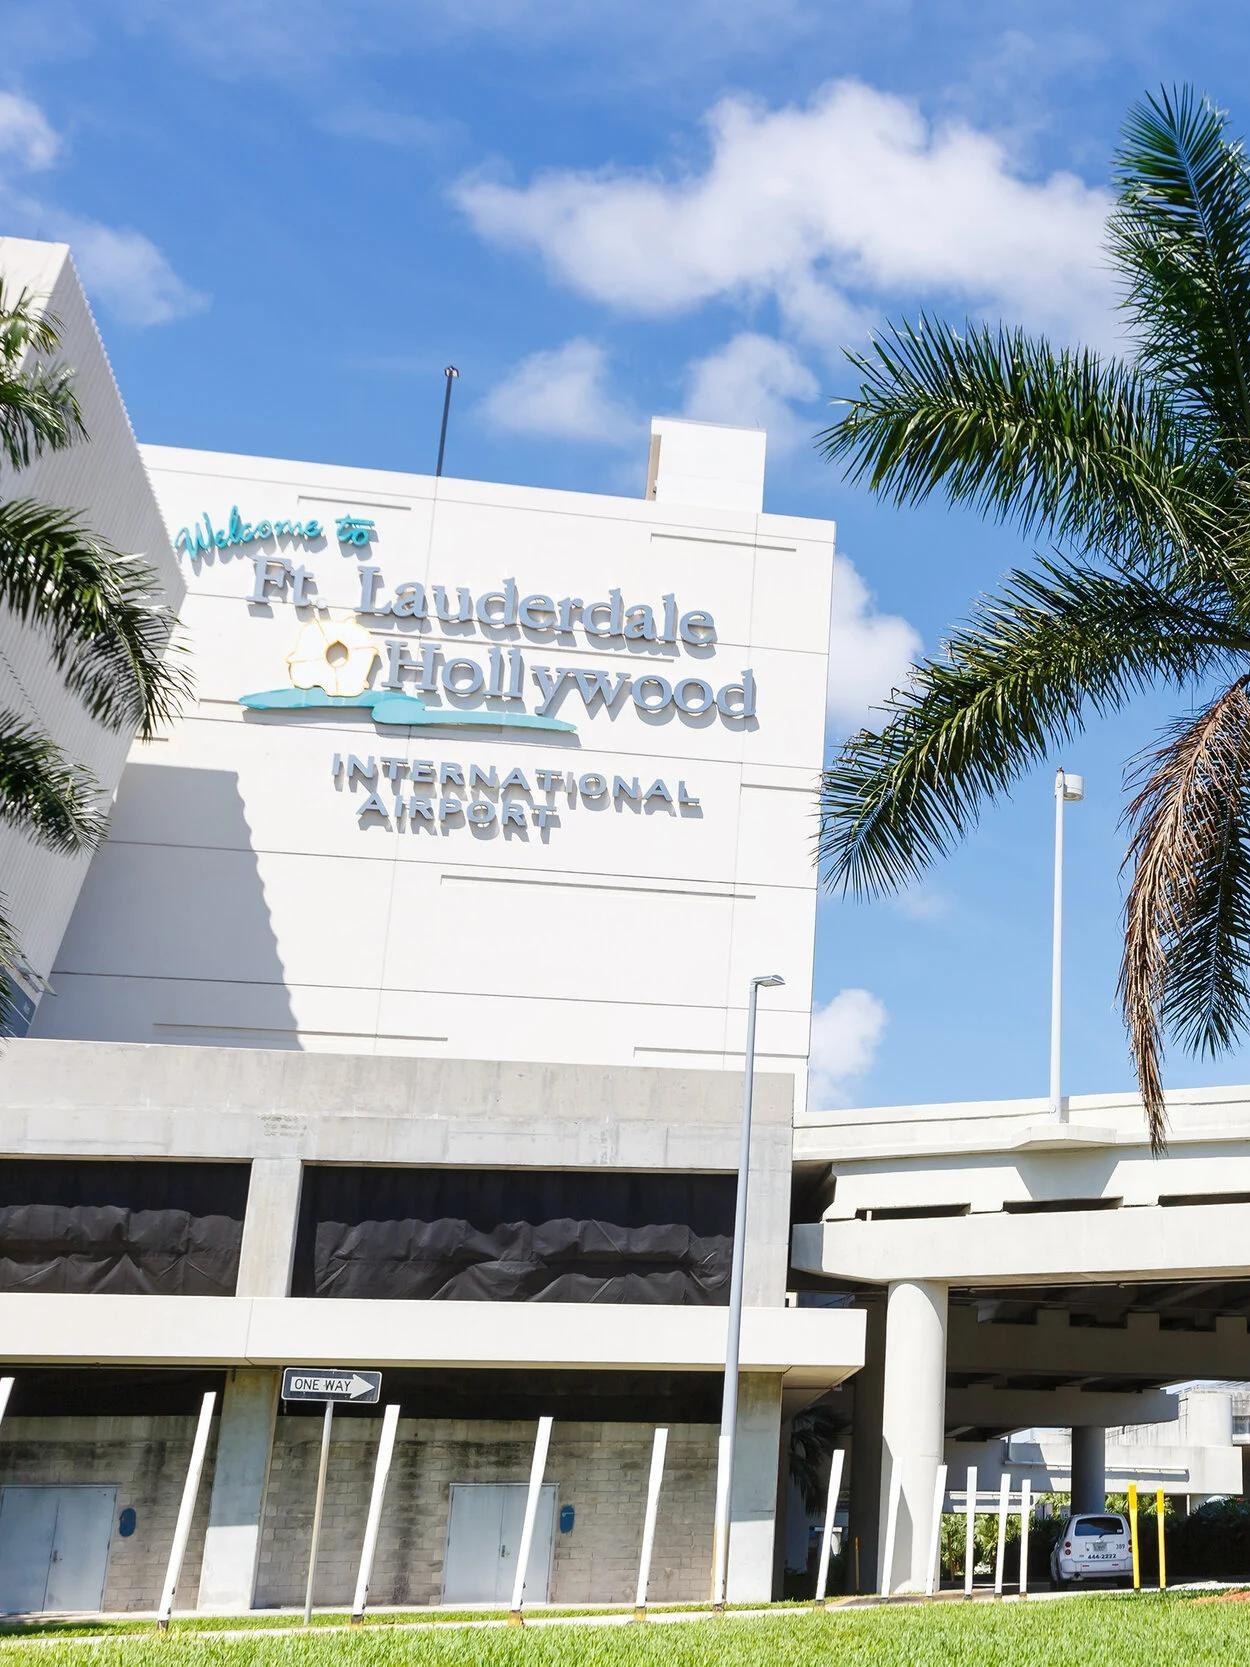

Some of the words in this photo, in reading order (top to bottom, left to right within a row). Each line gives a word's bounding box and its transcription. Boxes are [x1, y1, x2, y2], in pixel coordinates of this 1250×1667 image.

[174, 505, 323, 561] Welcome
[335, 515, 375, 547] to
[354, 566, 715, 645] Lauderdale
[381, 640, 757, 717] Hollywood
[331, 753, 700, 804] INTERNATIONAL
[357, 792, 557, 828] AIRPORT
[295, 1378, 319, 1391] ONE
[325, 1379, 351, 1392] WAY
